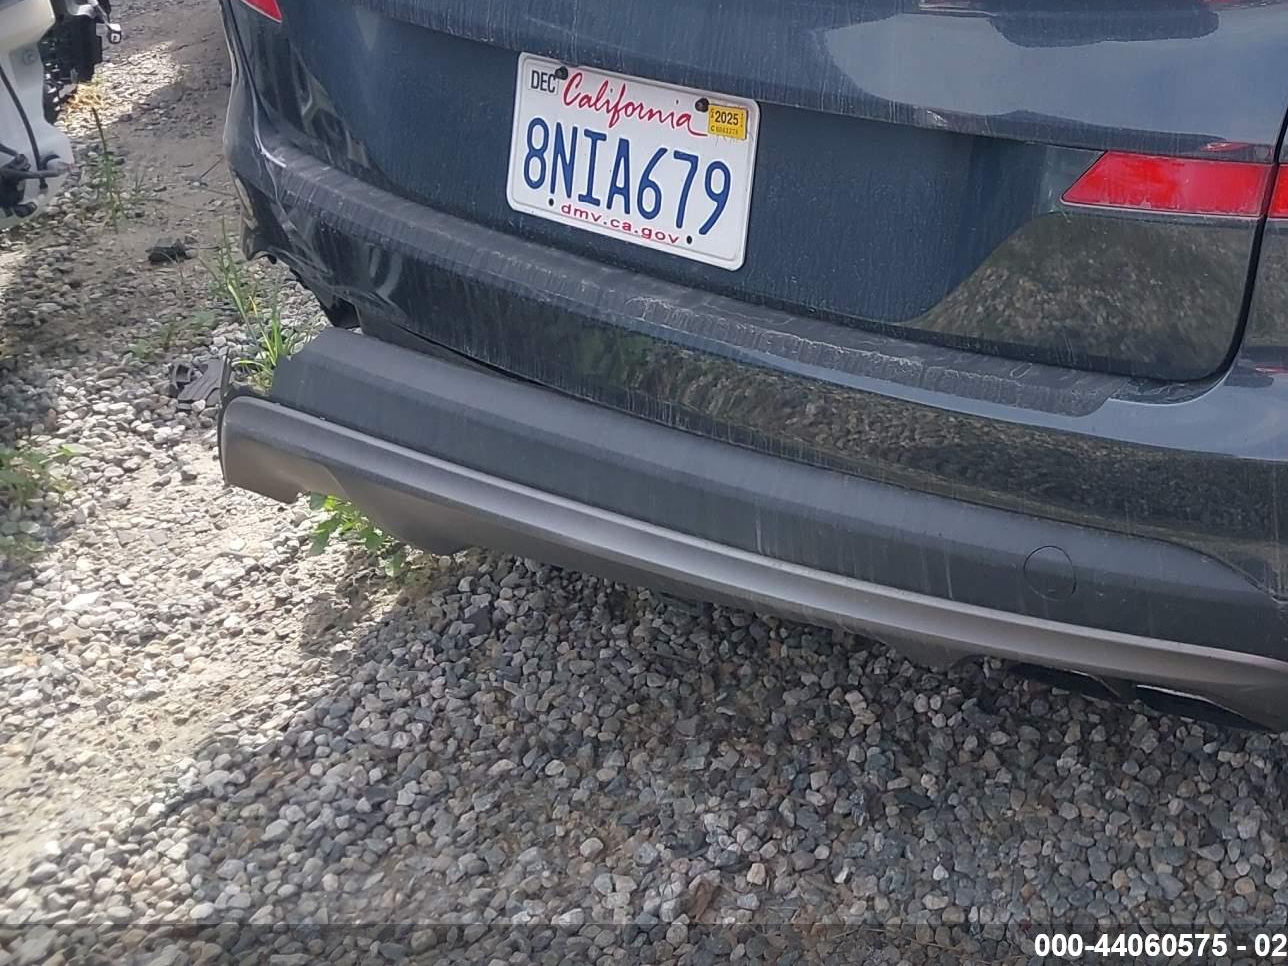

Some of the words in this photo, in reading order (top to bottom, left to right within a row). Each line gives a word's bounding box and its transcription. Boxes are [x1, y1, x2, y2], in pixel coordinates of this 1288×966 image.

[530, 69, 556, 94] DEC
[563, 72, 708, 137] California
[715, 110, 739, 126] 2025
[523, 117, 731, 236] 8NIA679
[561, 203, 680, 244] dmv.ca.gov
